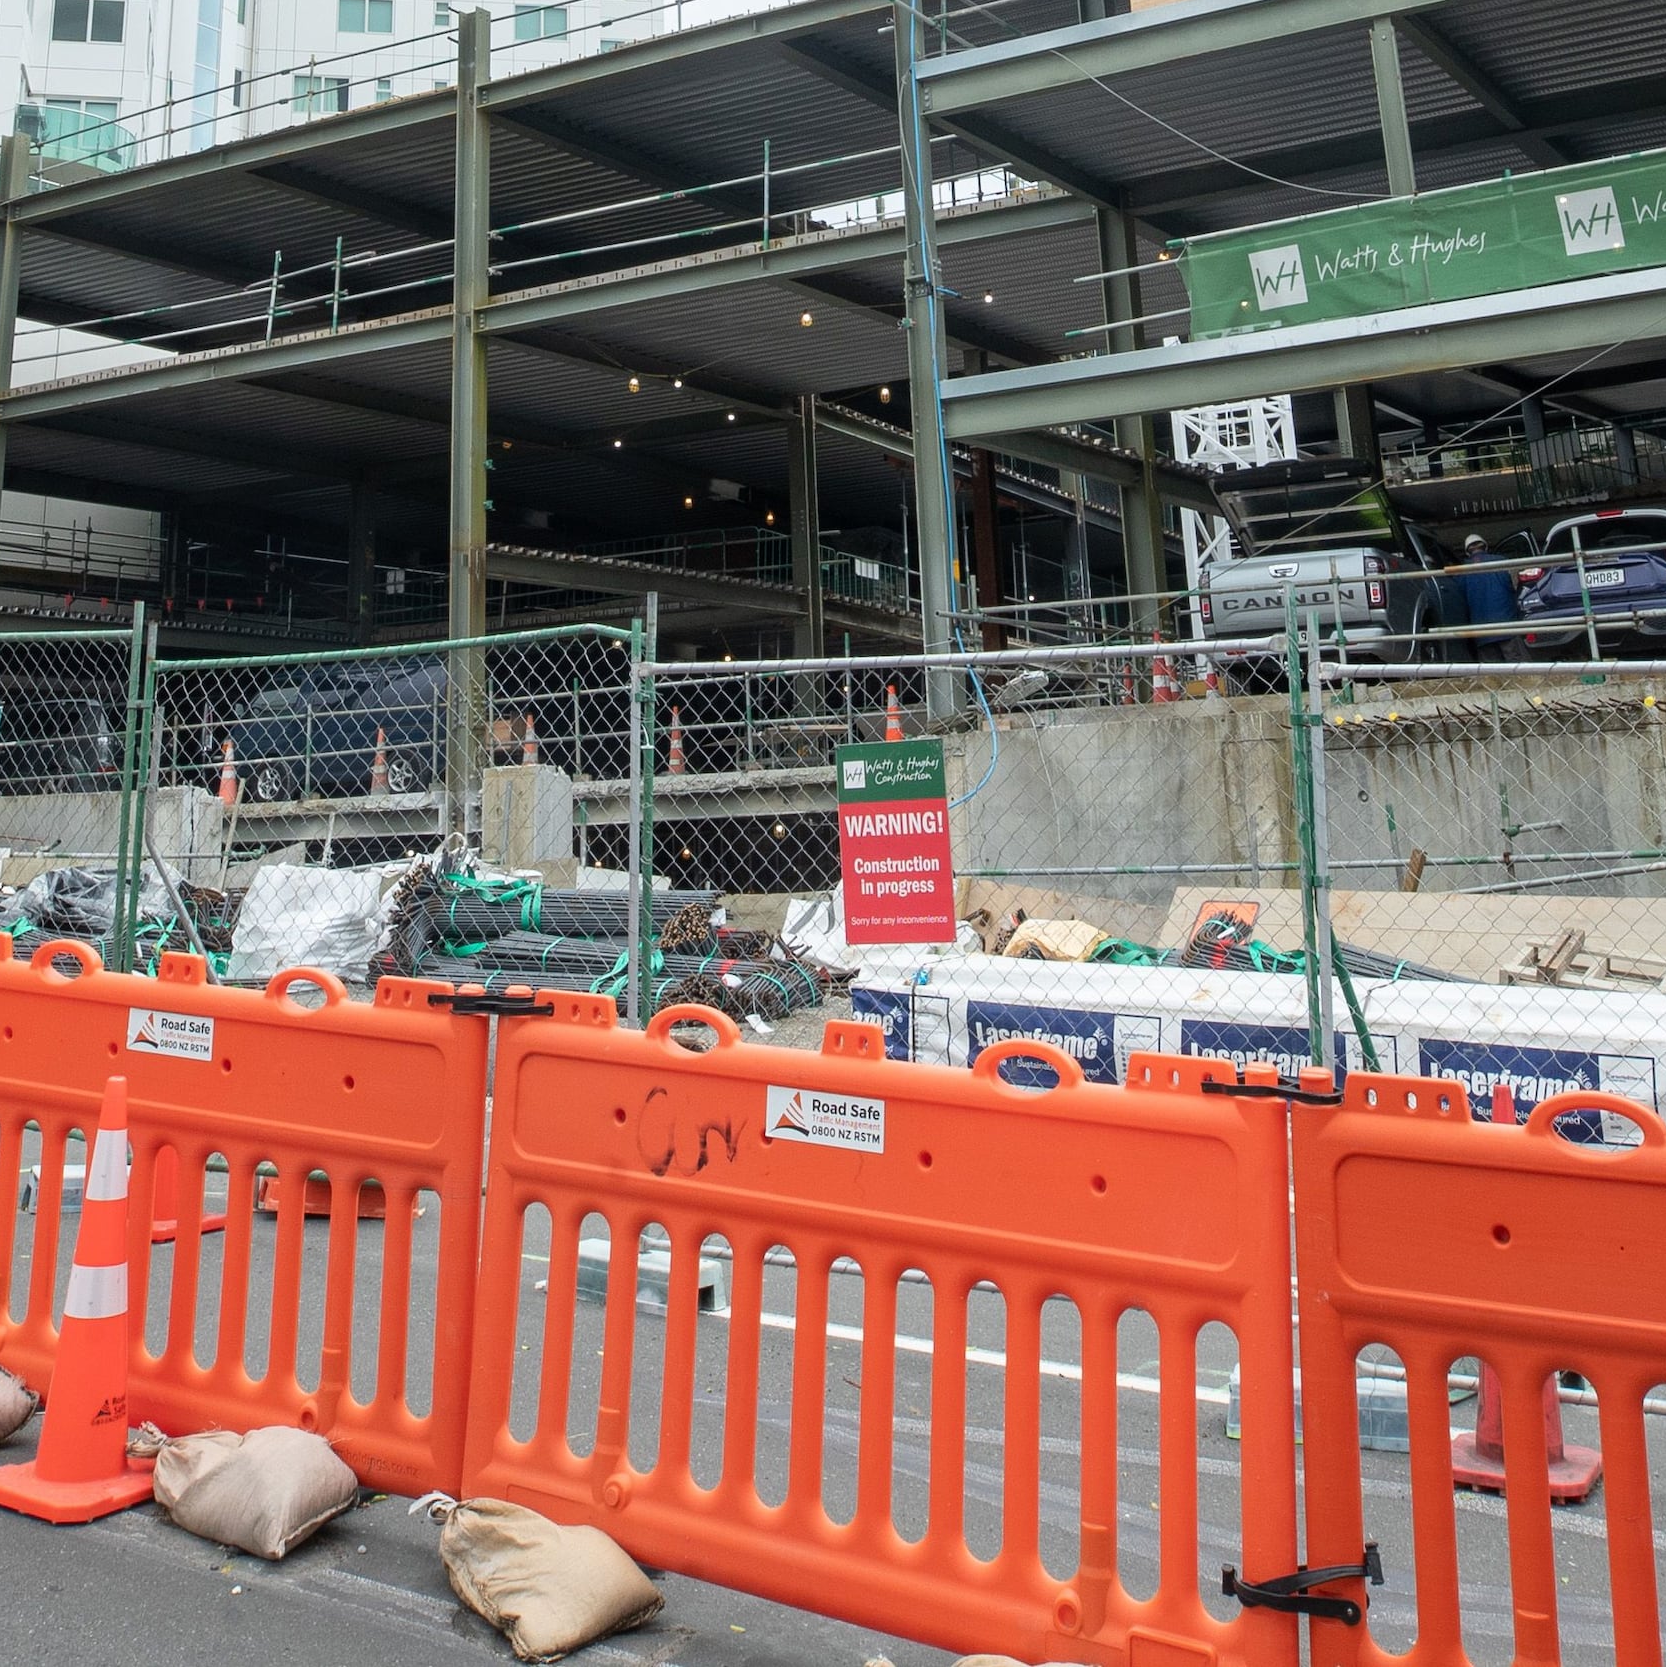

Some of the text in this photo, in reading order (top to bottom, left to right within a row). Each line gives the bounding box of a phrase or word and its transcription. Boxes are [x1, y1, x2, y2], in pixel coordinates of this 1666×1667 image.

[1564, 201, 1616, 242] WH
[1315, 226, 1488, 282] Watts & Hughes
[1256, 260, 1300, 297] WH
[1586, 571, 1620, 585] QHD83
[1222, 589, 1355, 611] CANNON
[845, 767, 864, 782] WH
[865, 756, 940, 775] Watts & Hughes
[874, 769, 933, 786] Construction
[845, 811, 944, 838] WARNING!
[854, 855, 940, 874] Construction
[861, 878, 935, 898] in progress
[851, 914, 948, 927] Sorry for any inconvenience
[161, 1017, 211, 1035] Road Safe
[159, 1038, 210, 1054] 0800 NZ RSTM
[1190, 1042, 1312, 1078] Laserfram
[812, 1099, 880, 1121] Road Safe
[812, 1114, 880, 1132] Traffic Management
[811, 1124, 881, 1144] 0800 NZ RSTM
